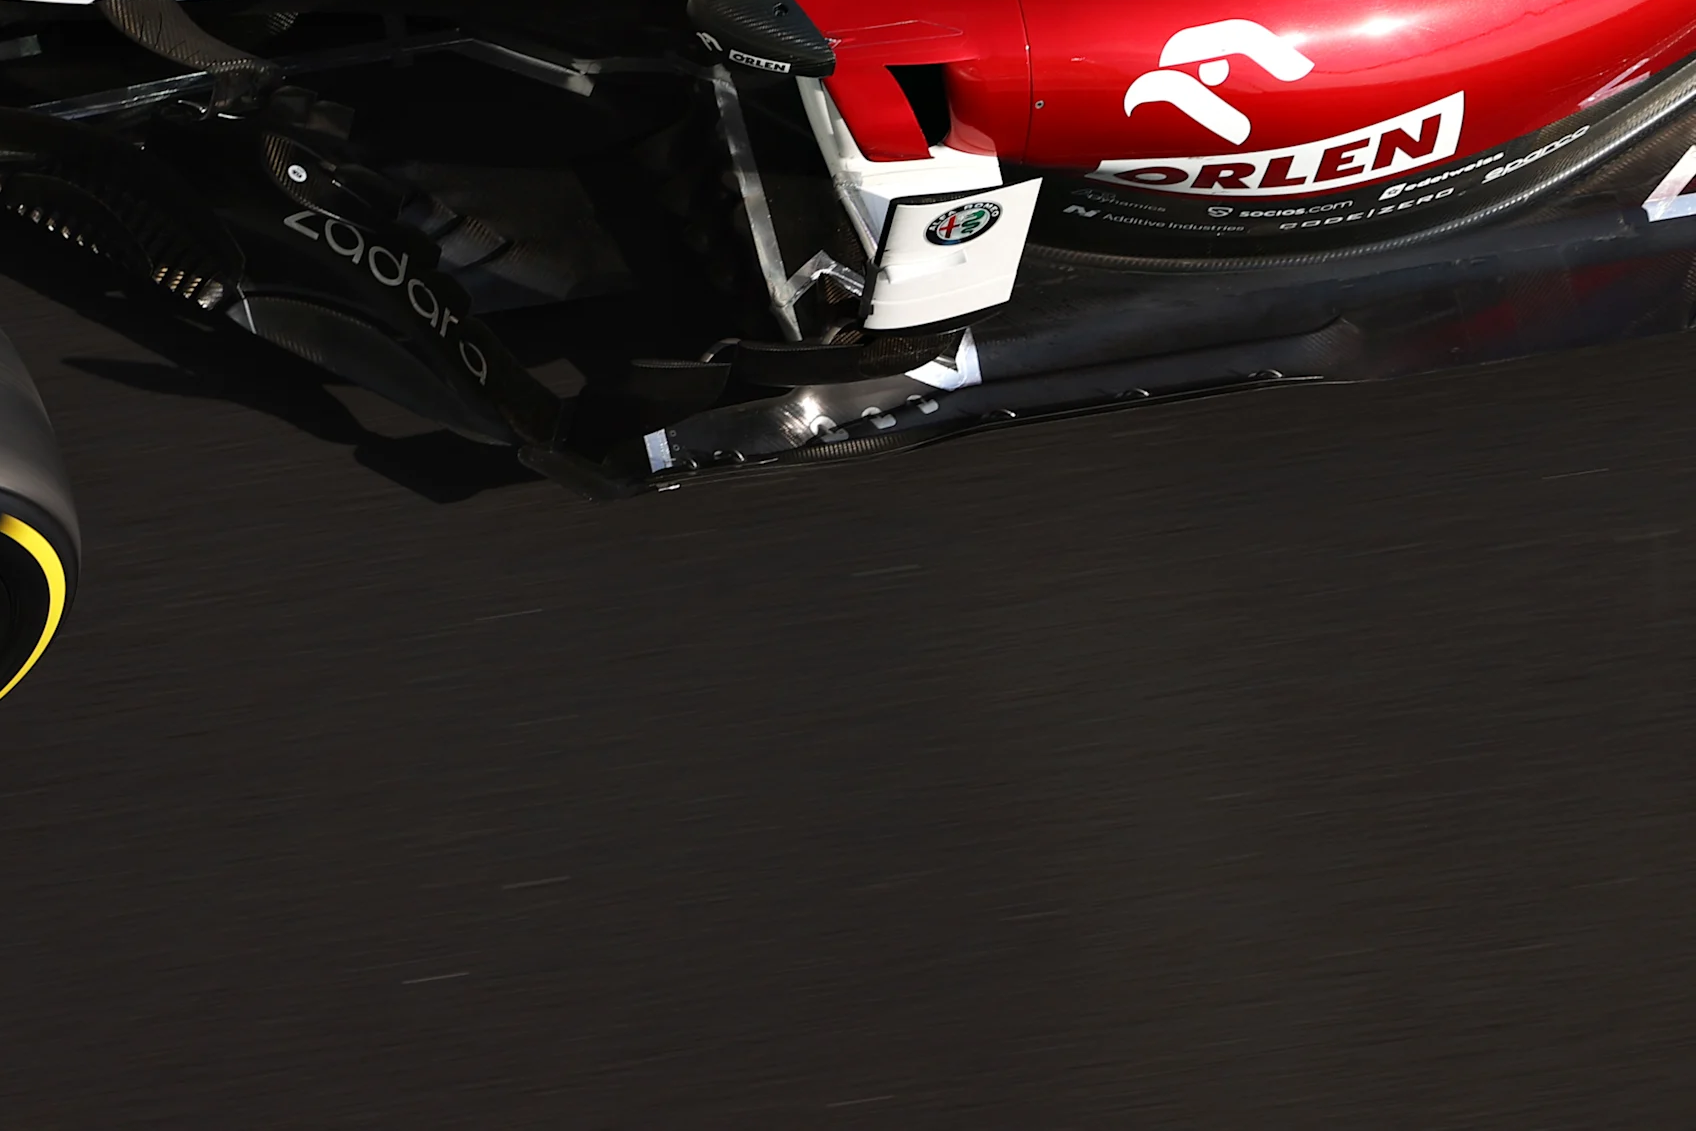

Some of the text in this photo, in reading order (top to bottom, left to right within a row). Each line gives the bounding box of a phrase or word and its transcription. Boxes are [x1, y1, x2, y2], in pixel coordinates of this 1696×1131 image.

[731, 52, 787, 72] ORLEN
[1115, 113, 1444, 191] ORLEN
[928, 202, 1000, 232] ALFA ROMEO
[1239, 200, 1354, 218] socios.com
[1103, 213, 1245, 233] Additive Industries
[283, 210, 488, 386] zadara
